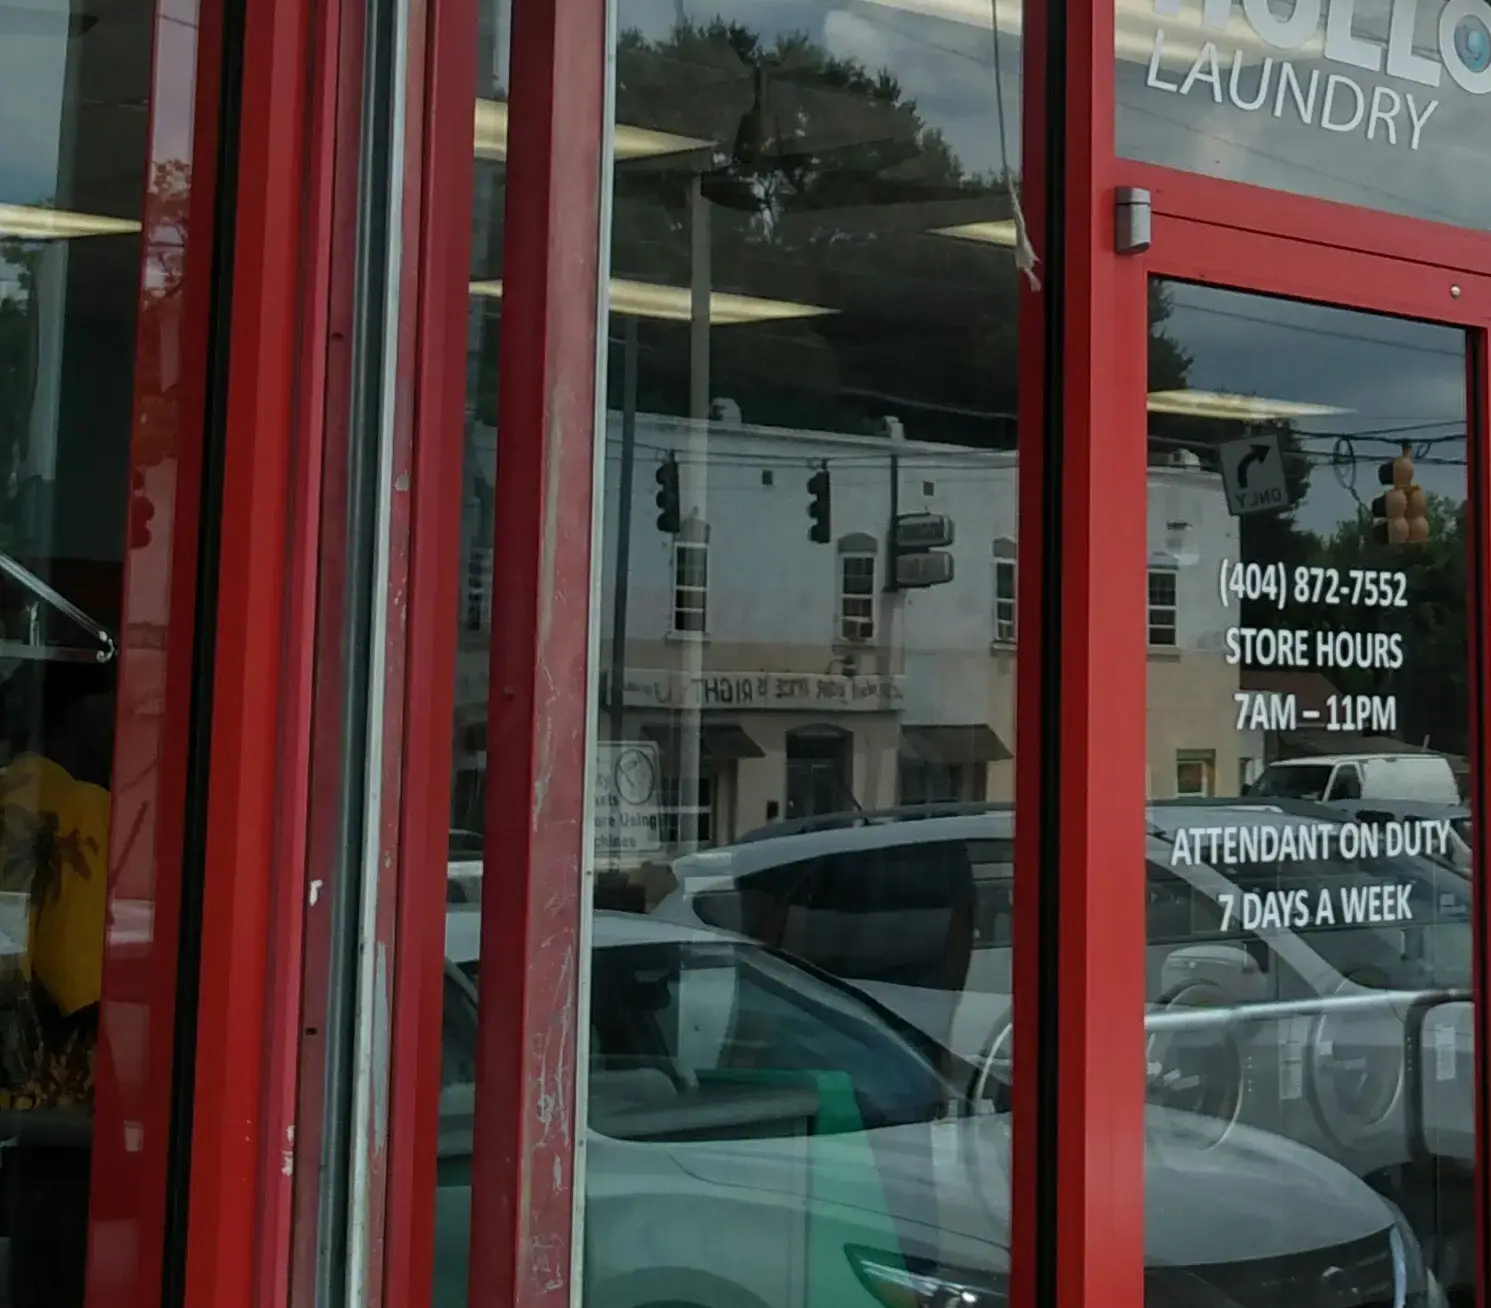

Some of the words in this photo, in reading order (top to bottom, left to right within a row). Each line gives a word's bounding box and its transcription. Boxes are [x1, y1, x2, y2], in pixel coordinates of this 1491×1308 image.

[1147, 29, 1439, 150] LAUNDRY
[1219, 559, 1288, 609] (404)
[1293, 568, 1408, 607] 872-7552
[1226, 627, 1309, 668] STORE
[1316, 630, 1403, 670] HOURS
[1234, 692, 1296, 731] 7AM
[1326, 694, 1397, 731] 11PM
[1171, 822, 1334, 866] ATTENDANT
[1339, 823, 1379, 858] ON
[1385, 818, 1451, 857] DUTY
[1219, 895, 1234, 931] 7
[1243, 891, 1311, 929] DAYS
[1315, 889, 1334, 924] A
[1341, 884, 1412, 924] WEEK
